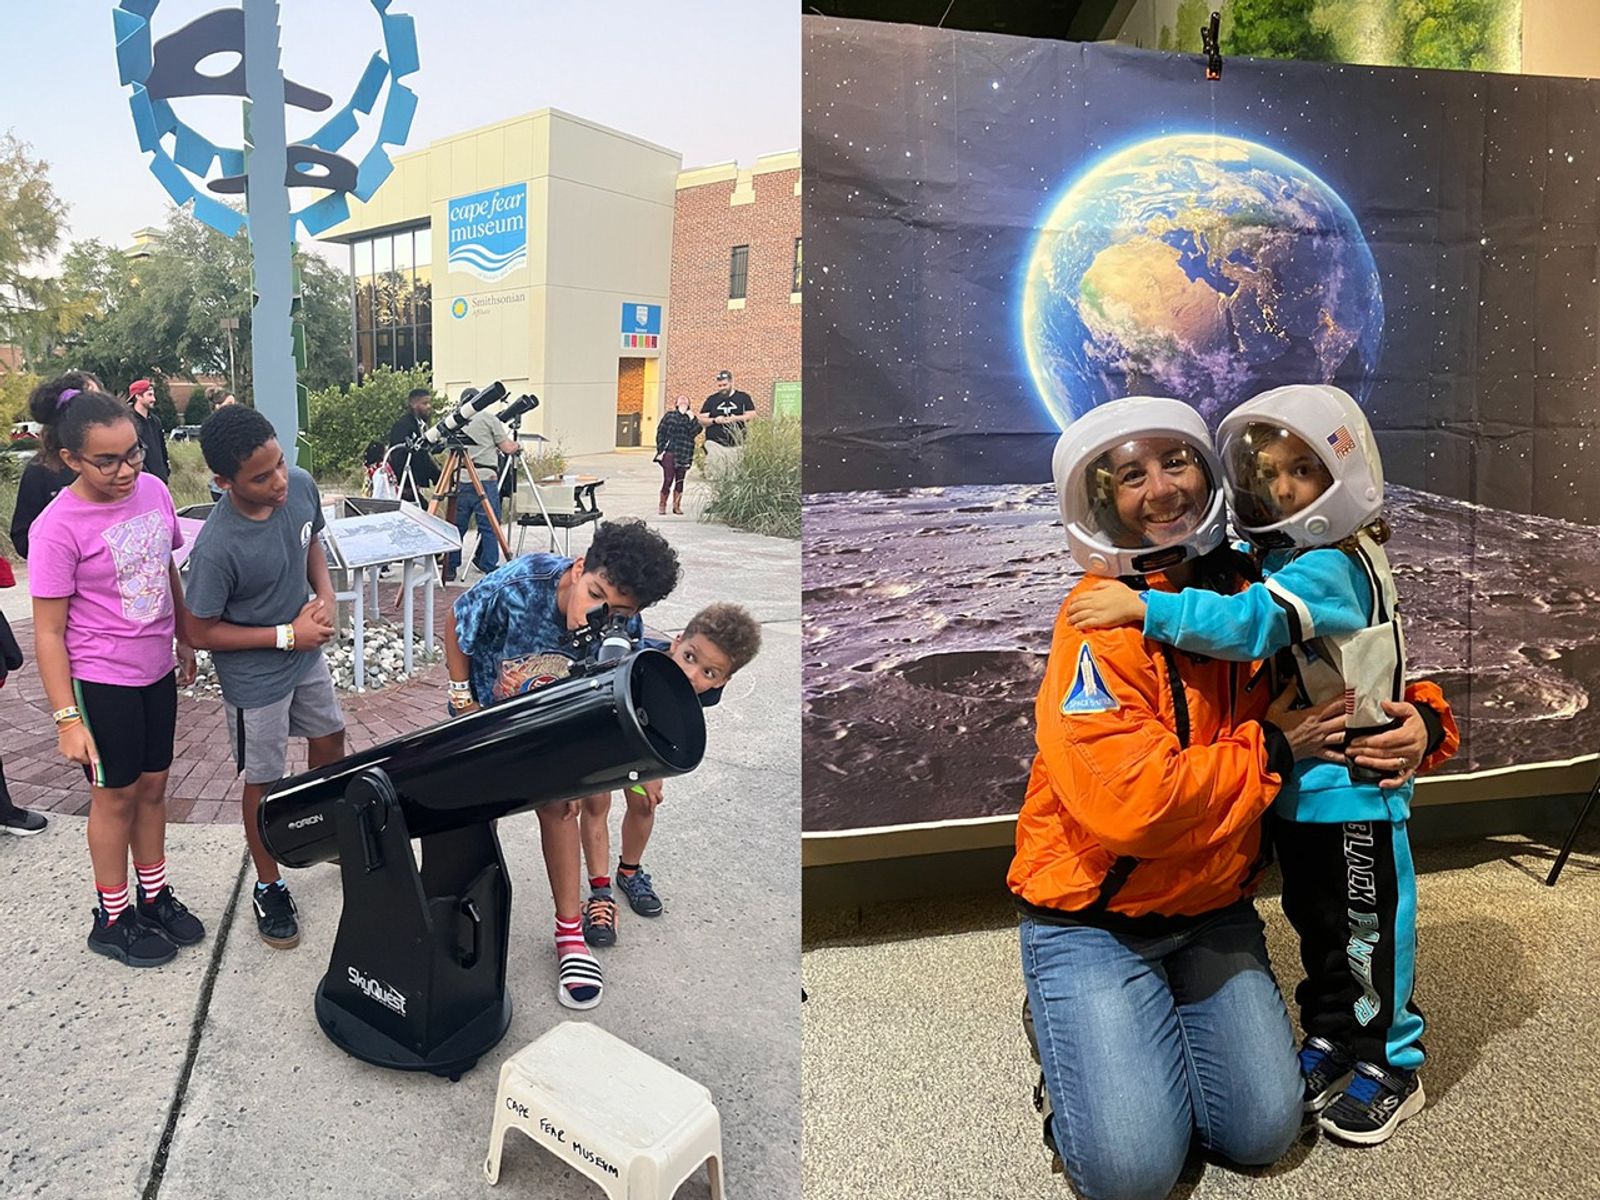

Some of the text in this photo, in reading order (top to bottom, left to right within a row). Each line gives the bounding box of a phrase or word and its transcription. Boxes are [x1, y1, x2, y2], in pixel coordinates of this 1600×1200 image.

[450, 191, 525, 223] cape fear
[451, 214, 524, 243] museum
[472, 293, 526, 308] Smithsonian
[295, 813, 324, 829] ORION
[1343, 821, 1377, 906] BLACK
[348, 966, 407, 1014] SkyQuest
[506, 1097, 619, 1178] CAPE FEAR MUSEUM
